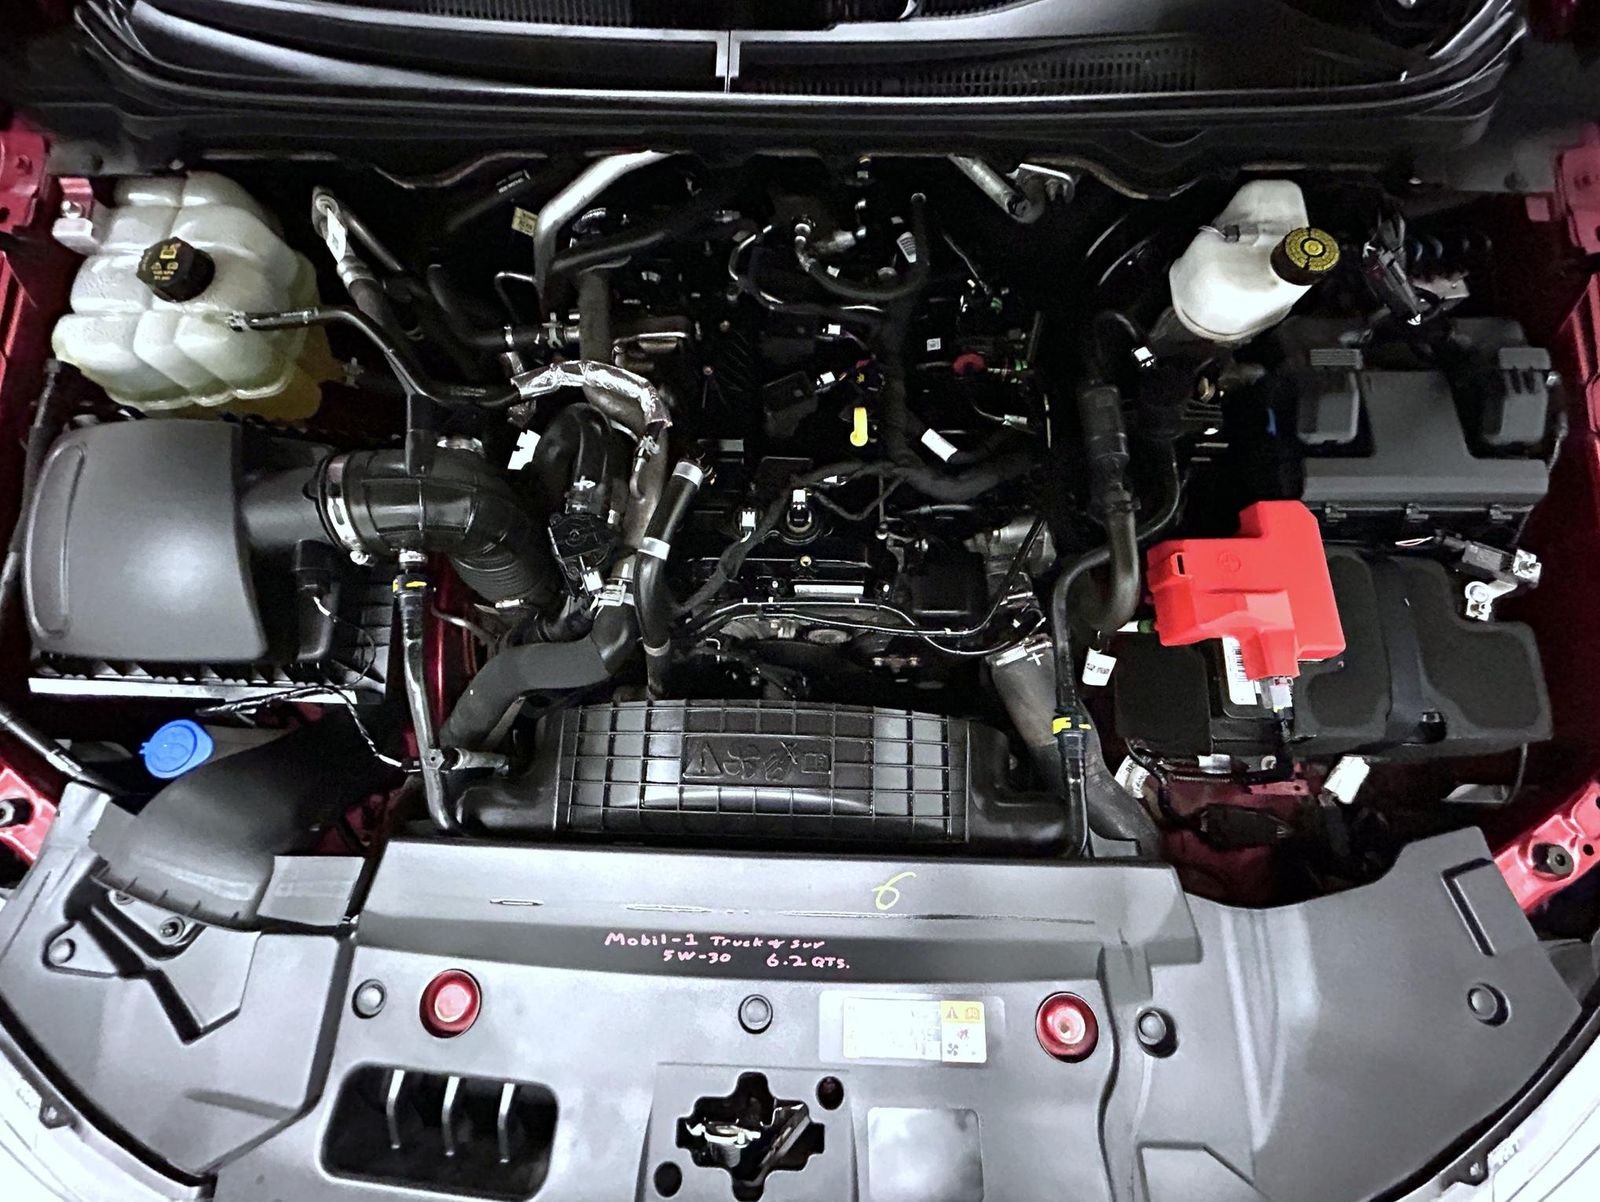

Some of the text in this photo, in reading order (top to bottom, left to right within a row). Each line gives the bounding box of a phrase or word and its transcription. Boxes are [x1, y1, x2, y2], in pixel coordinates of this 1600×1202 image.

[871, 871, 917, 910] 6
[604, 932, 699, 946] Mobil-1
[663, 949, 732, 964] 5W-30
[766, 953, 807, 967] 6.2
